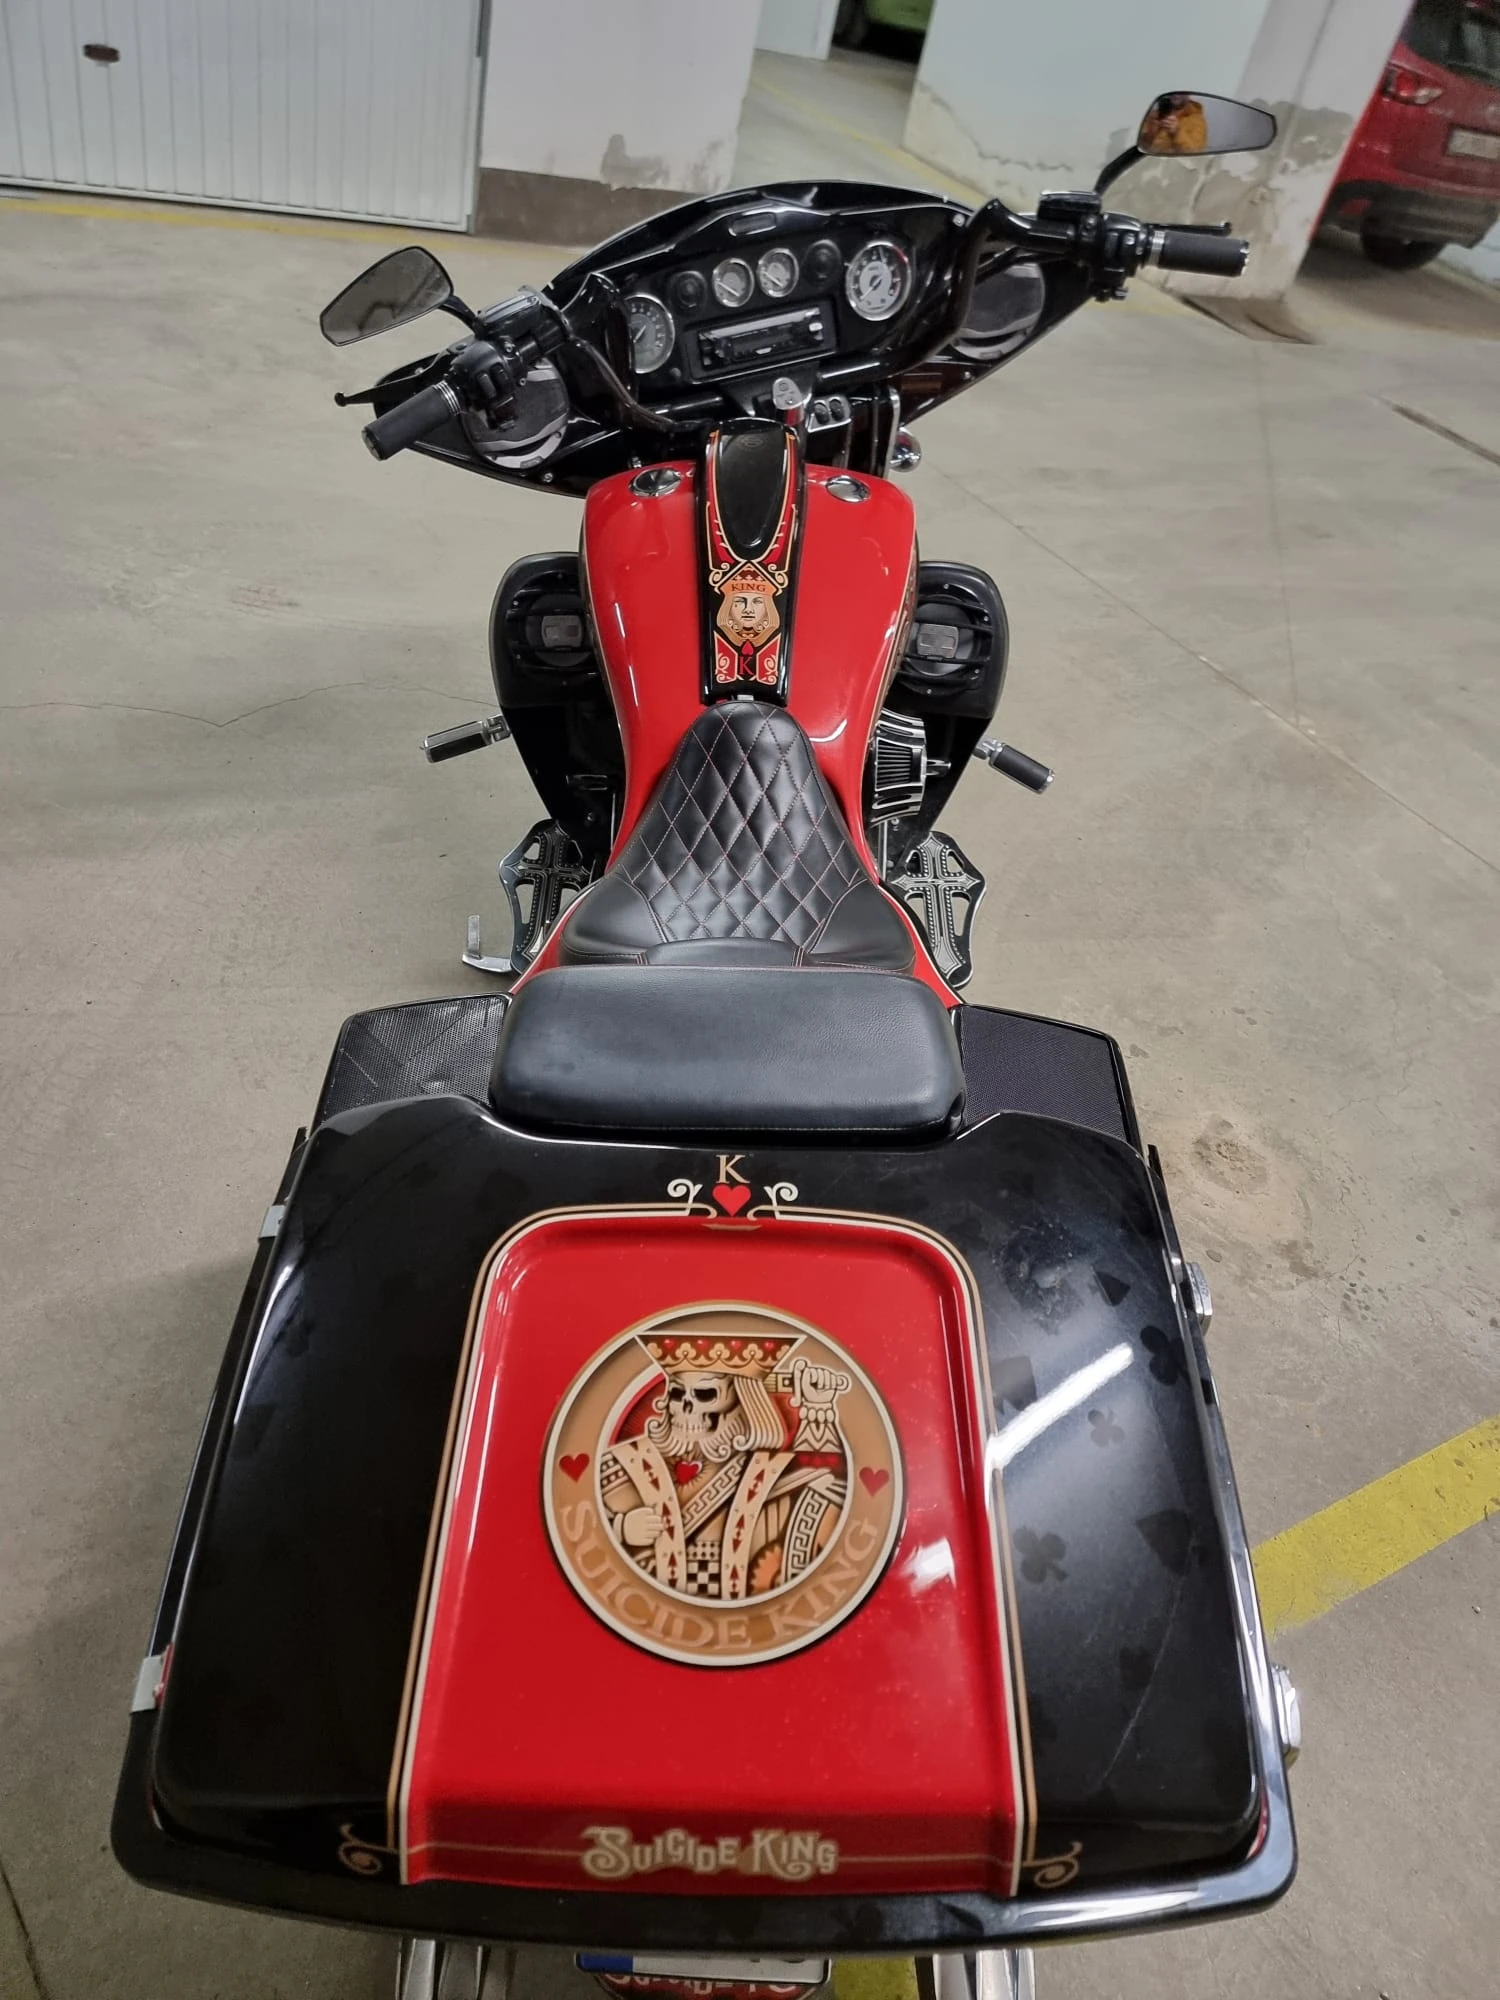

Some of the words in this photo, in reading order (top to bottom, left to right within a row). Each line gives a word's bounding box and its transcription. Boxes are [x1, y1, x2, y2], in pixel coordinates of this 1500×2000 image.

[731, 582, 766, 592] KING
[739, 656, 754, 675] K
[716, 1154, 750, 1184] K
[562, 1500, 752, 1648] SUICIDE
[769, 1518, 878, 1639] KING
